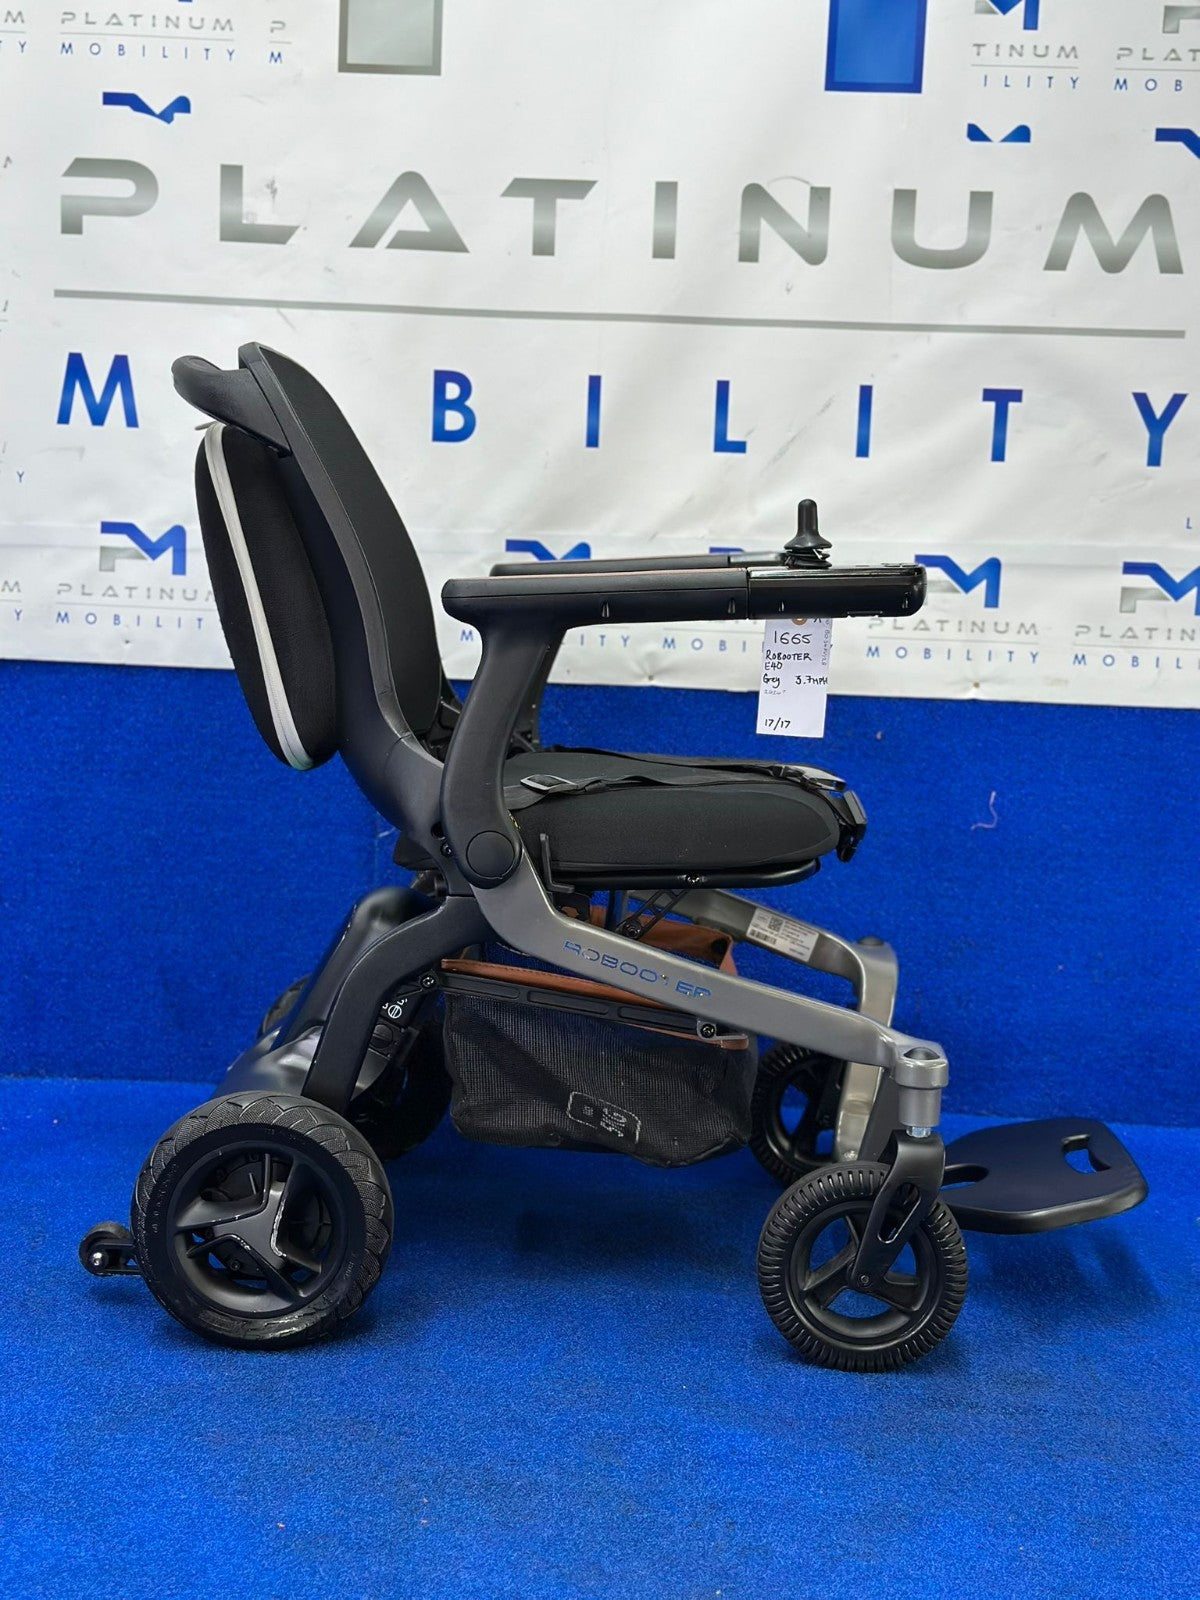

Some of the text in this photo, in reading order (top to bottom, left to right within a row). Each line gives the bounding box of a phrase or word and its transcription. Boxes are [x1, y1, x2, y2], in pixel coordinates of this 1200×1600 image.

[60, 11, 234, 32] PLATINUM
[60, 42, 235, 62] MOBILITY
[60, 157, 1184, 275] PLATINUM
[56, 352, 1189, 468] MBILITY
[56, 612, 204, 629] MOBILIT
[868, 618, 1039, 636] PLATINUM
[773, 630, 813, 645] 1665
[765, 649, 812, 661] ROBOOTER
[866, 646, 1040, 664] MOBILITY
[764, 661, 783, 671] E40
[764, 717, 791, 731] 17/17
[563, 940, 712, 998] ROBOOER
